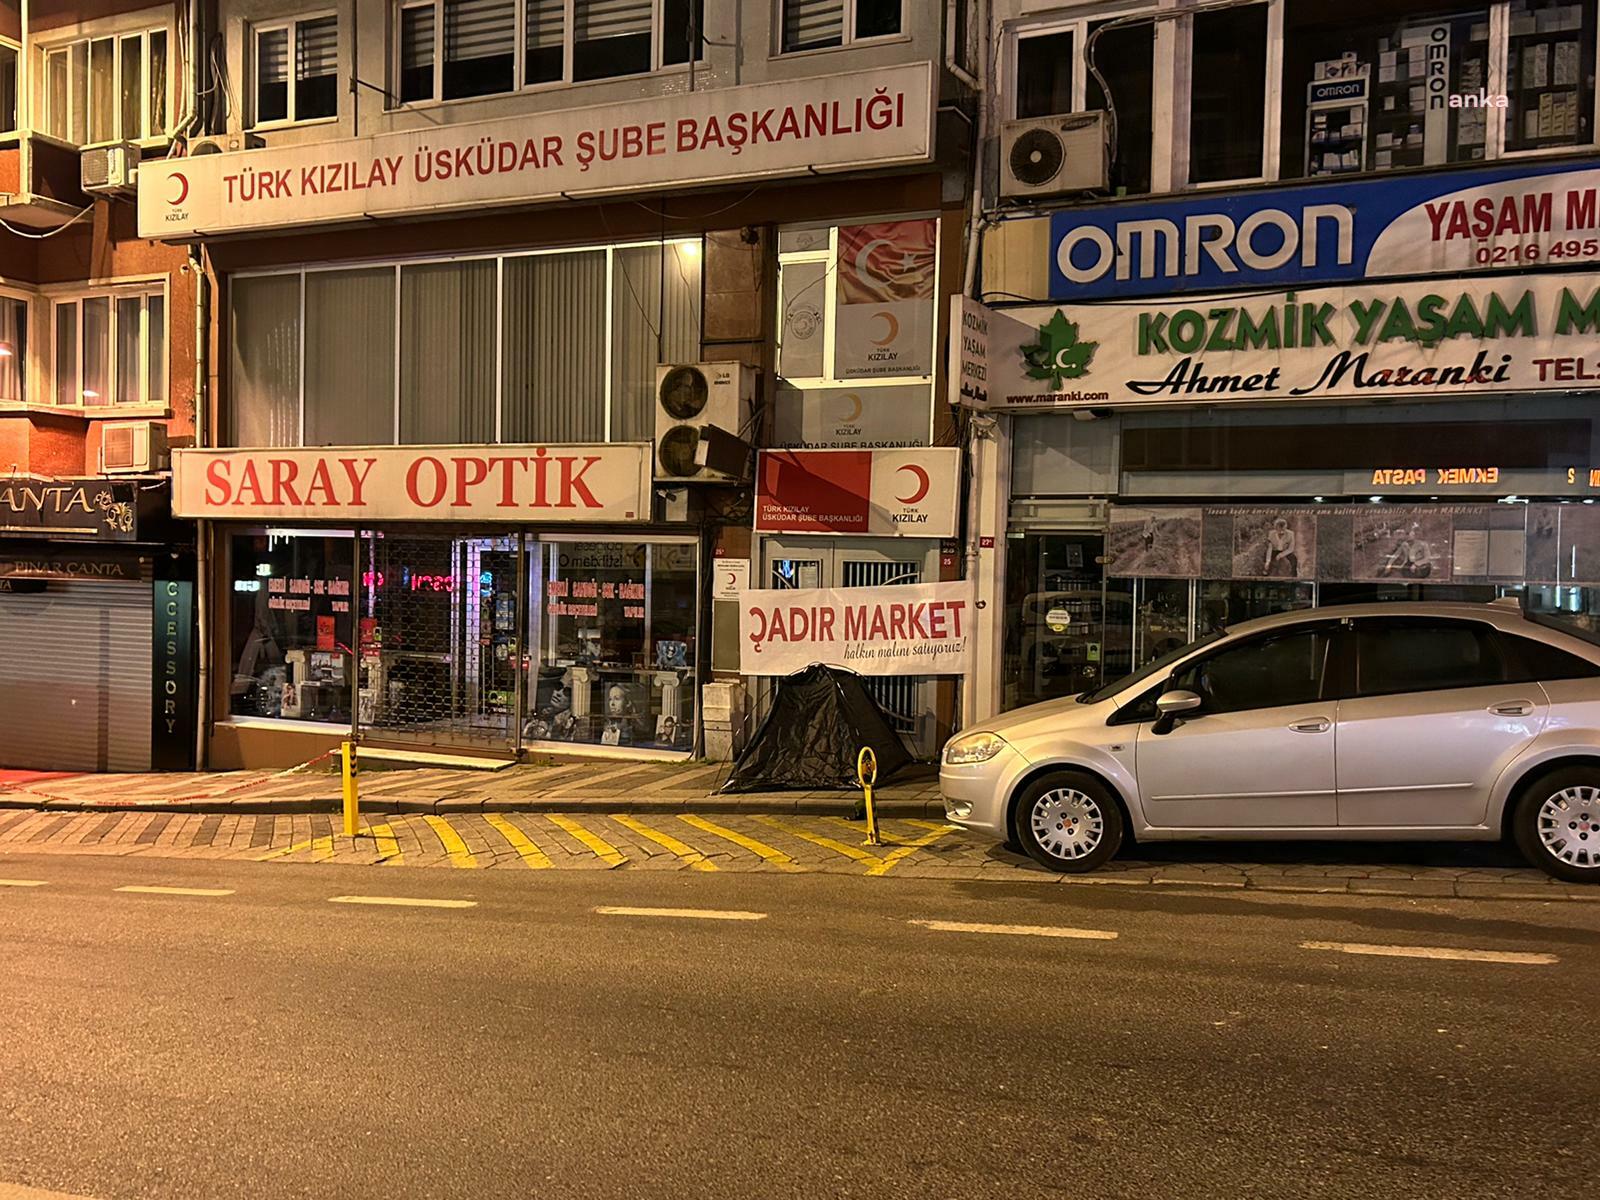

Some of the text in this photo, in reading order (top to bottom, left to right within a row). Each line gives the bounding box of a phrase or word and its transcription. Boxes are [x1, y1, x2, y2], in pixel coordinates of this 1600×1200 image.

[223, 86, 904, 204] TÜRK KIZILAY ÜSKÜDAR ŞUBE BAŞKANLIĞI
[165, 212, 189, 223] KIZILAY
[1424, 188, 1600, 243] YAŞAM M
[1475, 238, 1598, 264] 0216 495
[962, 309, 988, 336] KOZMİK
[1137, 291, 1336, 356] KOZMİK
[1349, 289, 1536, 349] YAŞAM
[867, 352, 898, 361] KIZILAY
[963, 335, 987, 359] YAŞAM
[961, 358, 987, 382] MERKEZİ
[1125, 356, 1281, 395] Ahmet
[1289, 350, 1513, 396] Maranki
[1006, 390, 1109, 404] www.maranki.com
[835, 428, 862, 436] KIZILAY
[205, 447, 604, 508] SARAY OPTİK
[762, 513, 863, 523] ÜSKÜDAR ŞUBE BAŞKANLIĞI
[763, 505, 810, 513] TÜRK KIZILAY
[892, 513, 928, 524] KIZILAY
[14, 560, 124, 577] PINAR ÇANTA
[844, 600, 966, 642] MARKET
[166, 564, 178, 733] CCESSORY
[844, 635, 967, 661] halkın malını satıyoruz!
